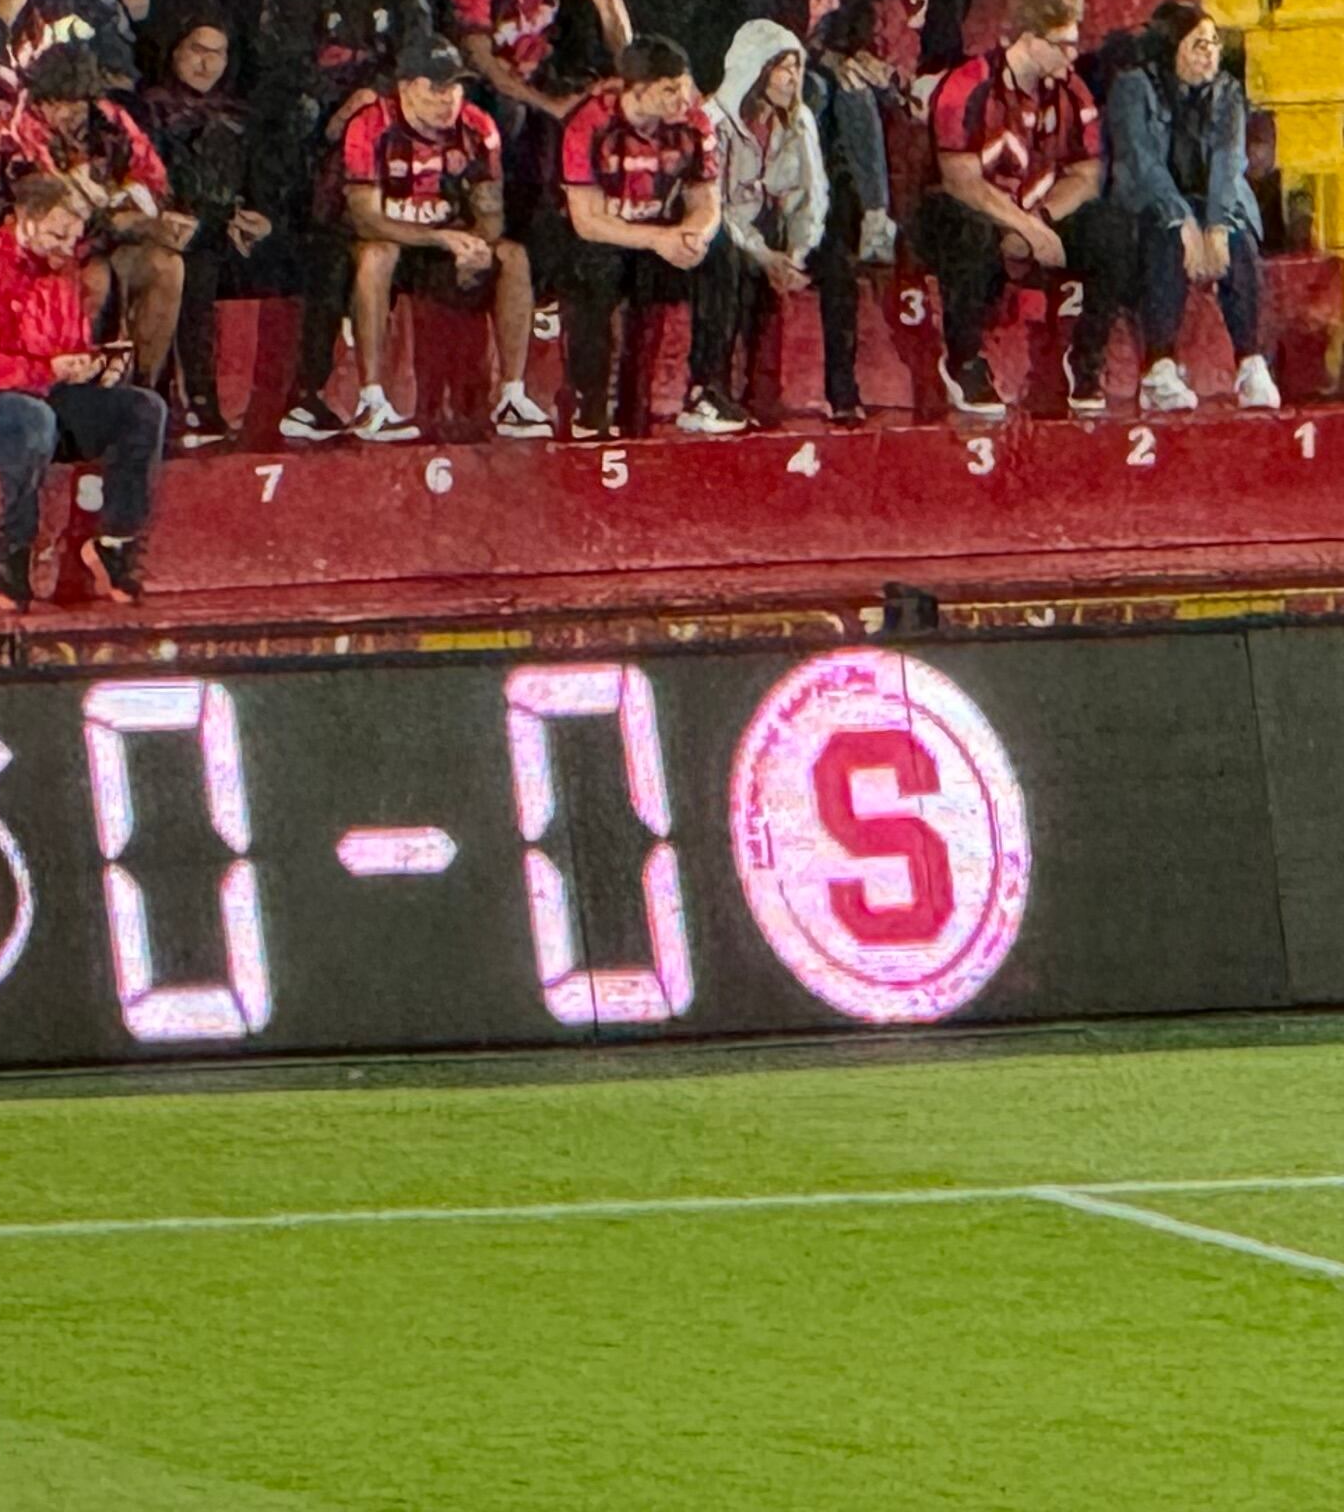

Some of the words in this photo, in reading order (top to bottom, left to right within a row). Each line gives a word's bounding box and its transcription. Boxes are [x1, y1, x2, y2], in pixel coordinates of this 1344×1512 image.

[898, 289, 926, 327] 3
[785, 441, 821, 478] 4
[966, 437, 996, 476] 3
[1125, 426, 1156, 467] 2
[1293, 420, 1316, 460] 1
[254, 463, 284, 503] 7
[424, 456, 454, 494] 6
[600, 449, 630, 490] 5
[82, 680, 272, 1042] 0
[504, 662, 695, 1025] 0
[812, 728, 955, 946] S
